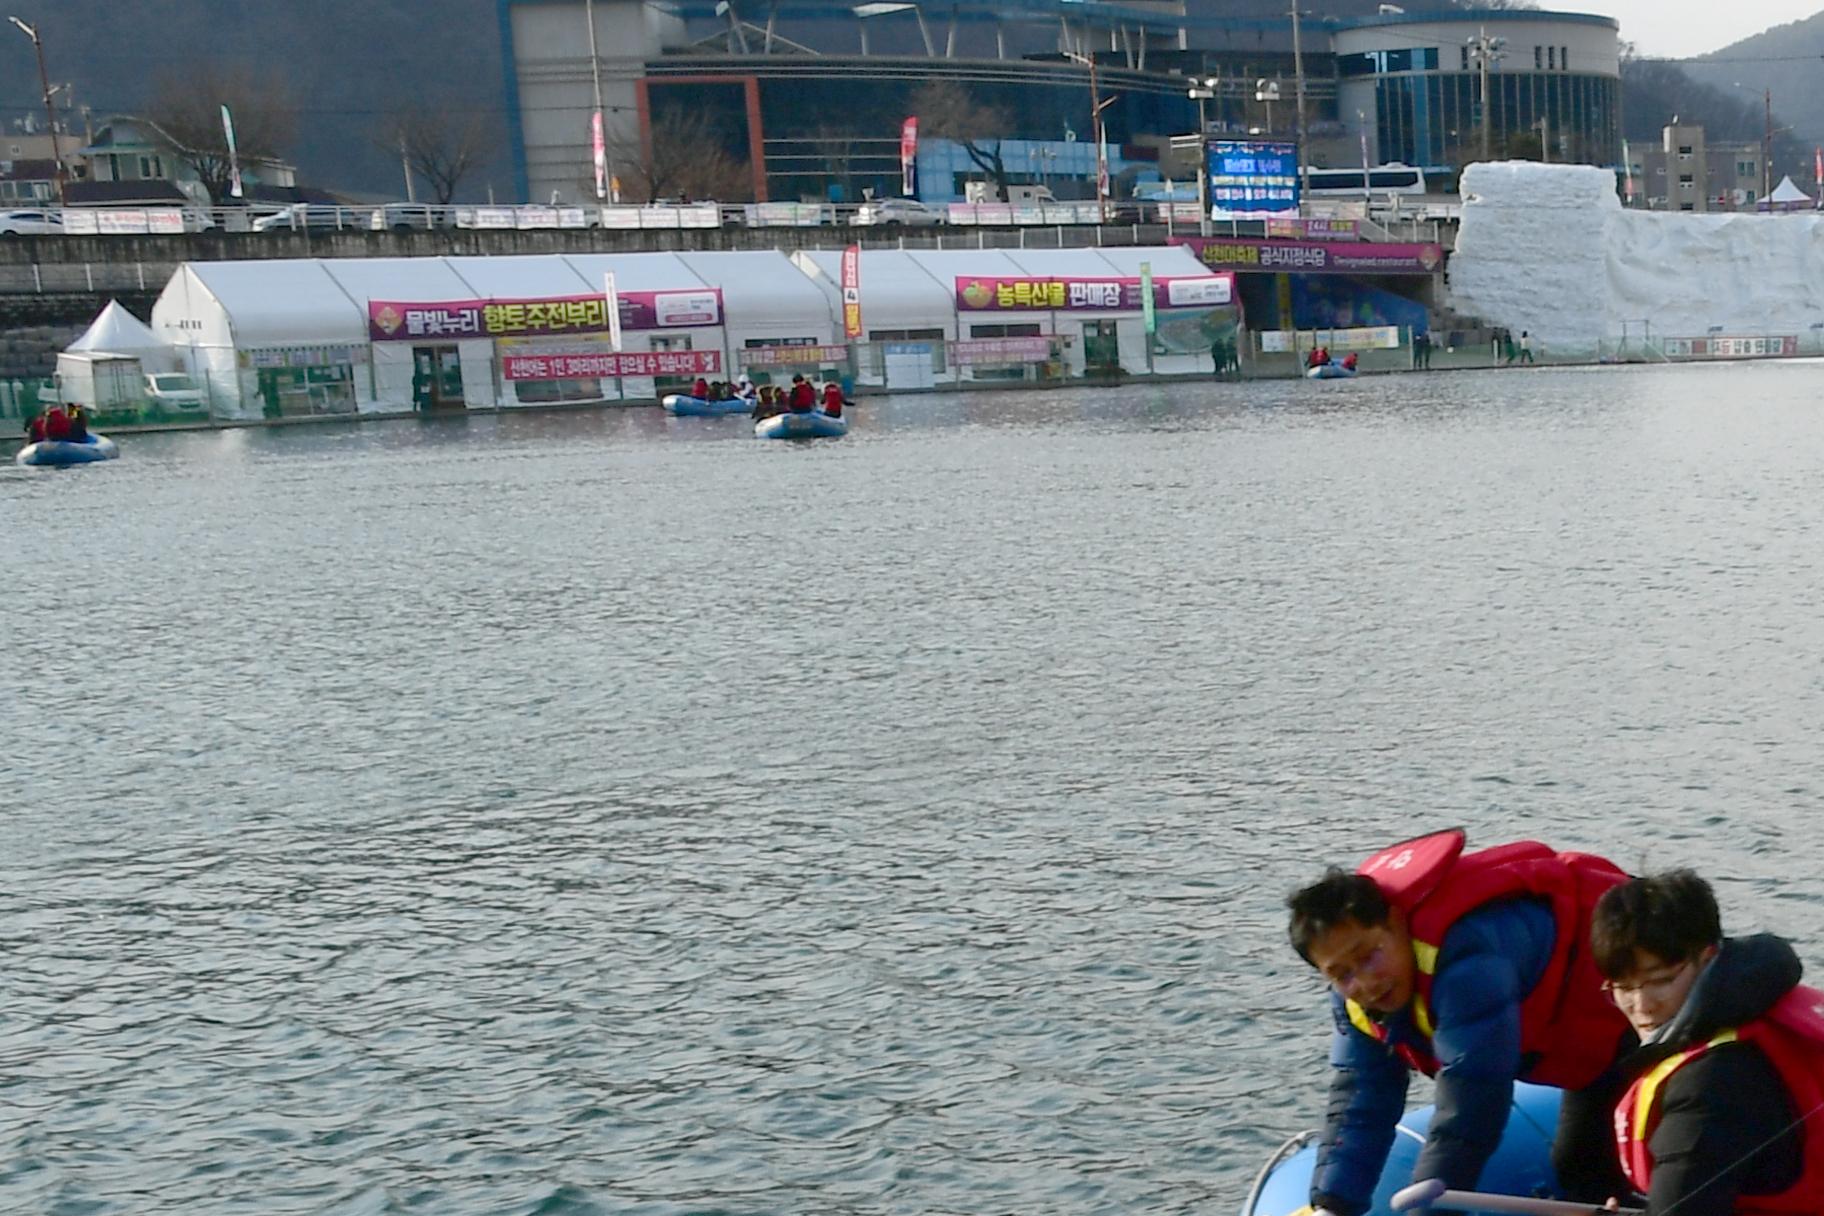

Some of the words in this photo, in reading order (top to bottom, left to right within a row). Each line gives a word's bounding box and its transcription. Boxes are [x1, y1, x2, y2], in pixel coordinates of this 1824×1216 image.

[1261, 247, 1326, 266] 공식지정식당
[997, 282, 1066, 306] 농특산물
[1069, 282, 1121, 306] 판매장
[406, 309, 480, 335] 물빛누리
[484, 299, 607, 333] 향토주전부리
[647, 353, 657, 371] 수
